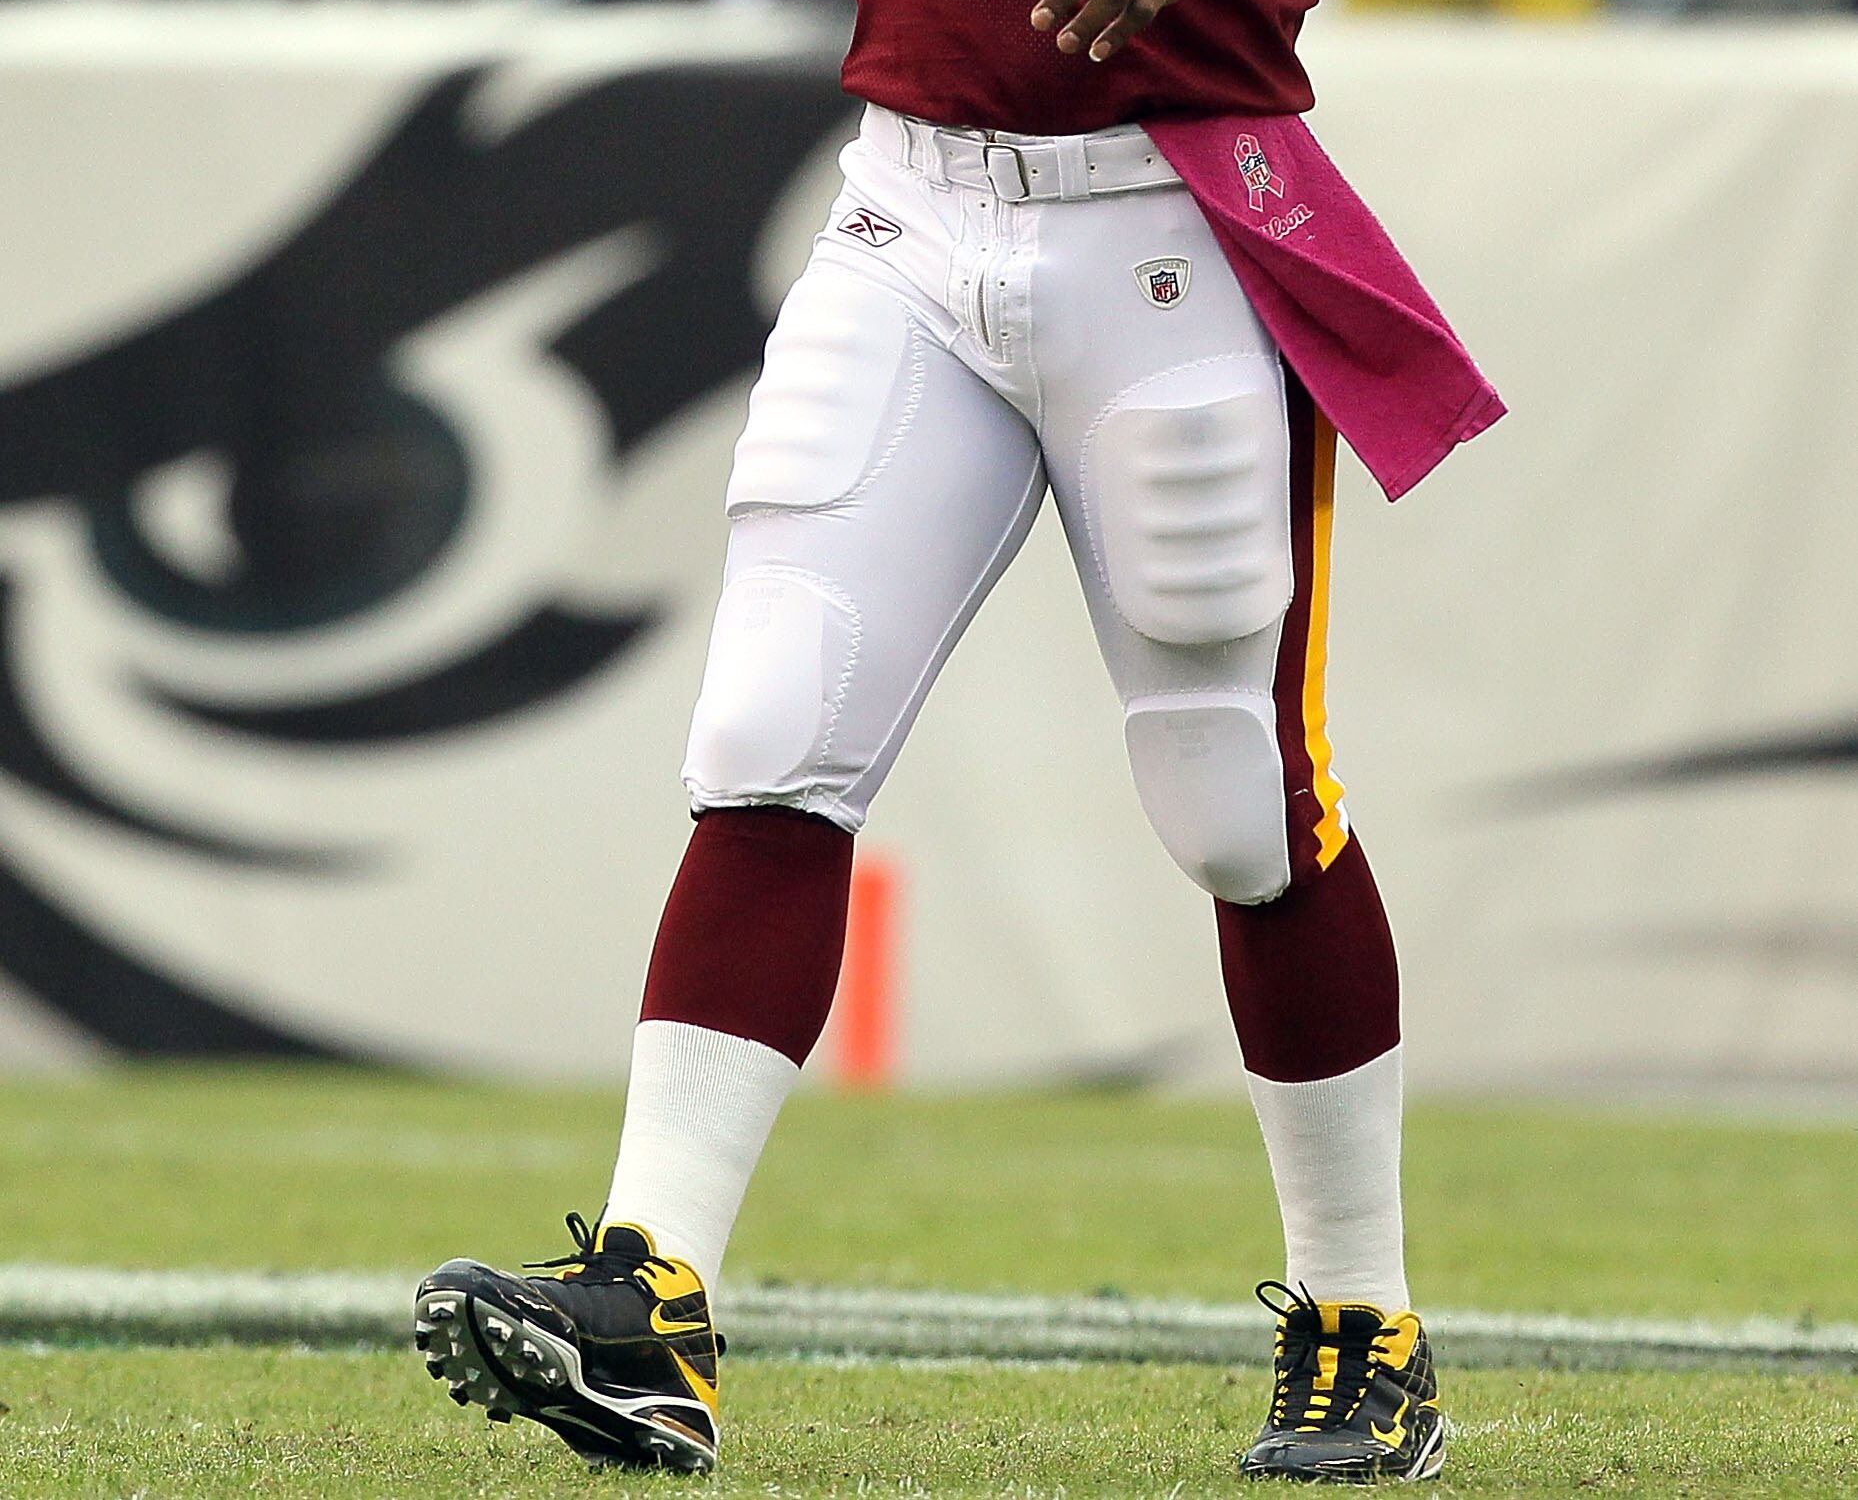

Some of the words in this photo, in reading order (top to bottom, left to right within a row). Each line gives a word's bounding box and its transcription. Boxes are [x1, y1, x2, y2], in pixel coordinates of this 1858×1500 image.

[1246, 164, 1270, 188] NFL
[1258, 203, 1315, 240] lson
[1153, 284, 1178, 300] NFL
